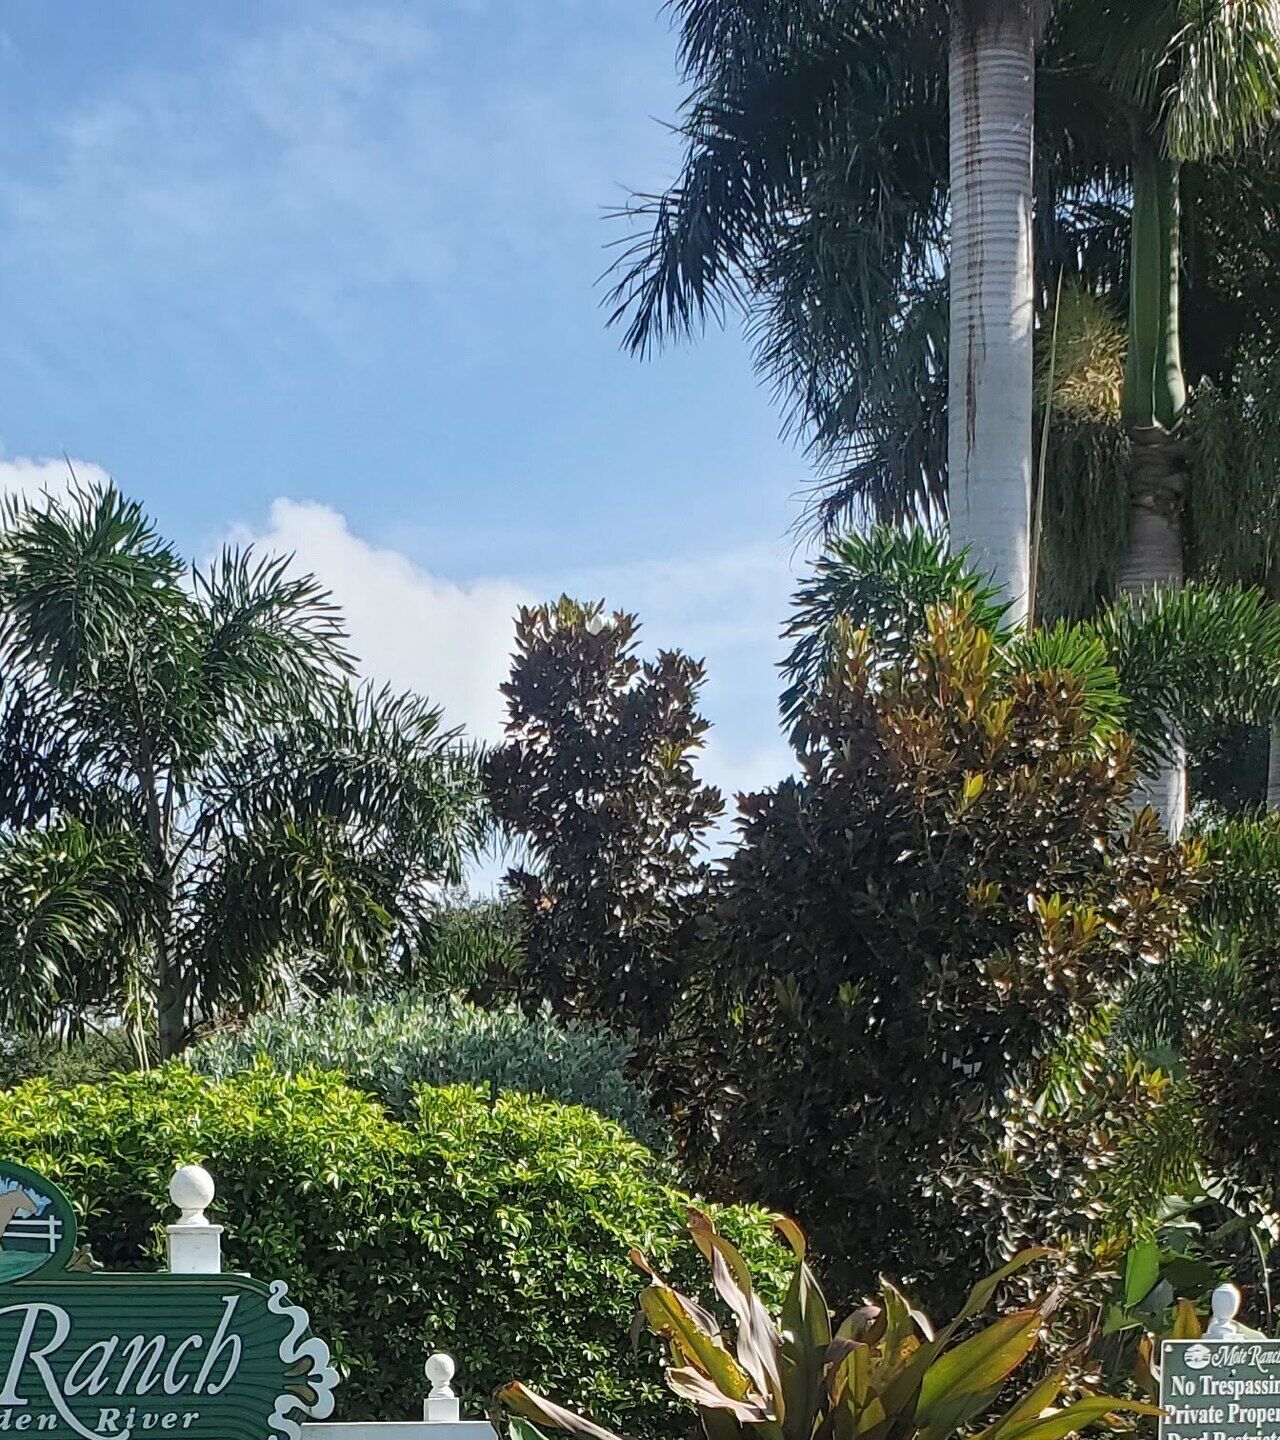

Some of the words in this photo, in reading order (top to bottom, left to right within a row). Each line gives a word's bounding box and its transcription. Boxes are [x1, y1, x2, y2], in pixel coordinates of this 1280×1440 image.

[1212, 1344, 1247, 1366] Mote
[1171, 1376, 1195, 1396] No
[96, 1408, 201, 1432] River
[1164, 1405, 1223, 1424] Private
